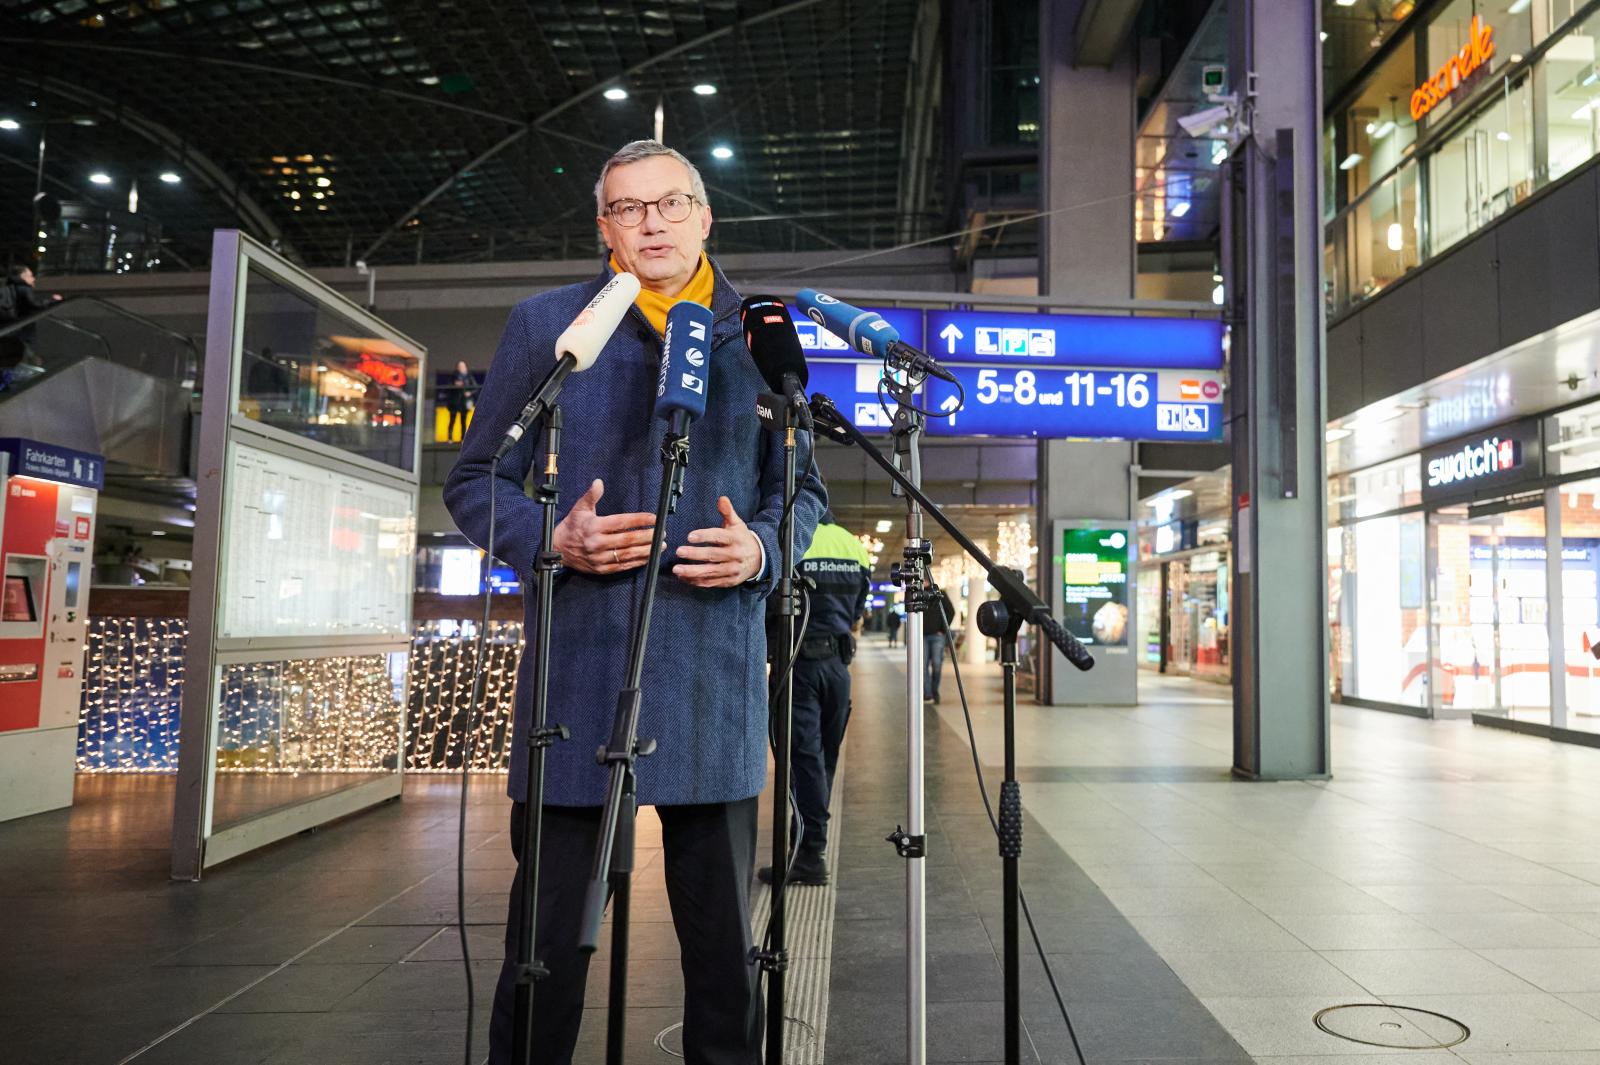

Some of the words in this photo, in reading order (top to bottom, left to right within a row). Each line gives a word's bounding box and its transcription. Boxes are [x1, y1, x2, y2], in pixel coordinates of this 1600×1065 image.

[1411, 15, 1494, 121] essanelle
[976, 369, 1037, 405] 5-8
[1038, 391, 1064, 406] und
[1064, 372, 1150, 408] 11-16
[26, 448, 66, 467] Fahrkarten
[1428, 437, 1499, 487] swatch
[803, 562, 818, 571] DB
[820, 562, 861, 572] Sicherheit
